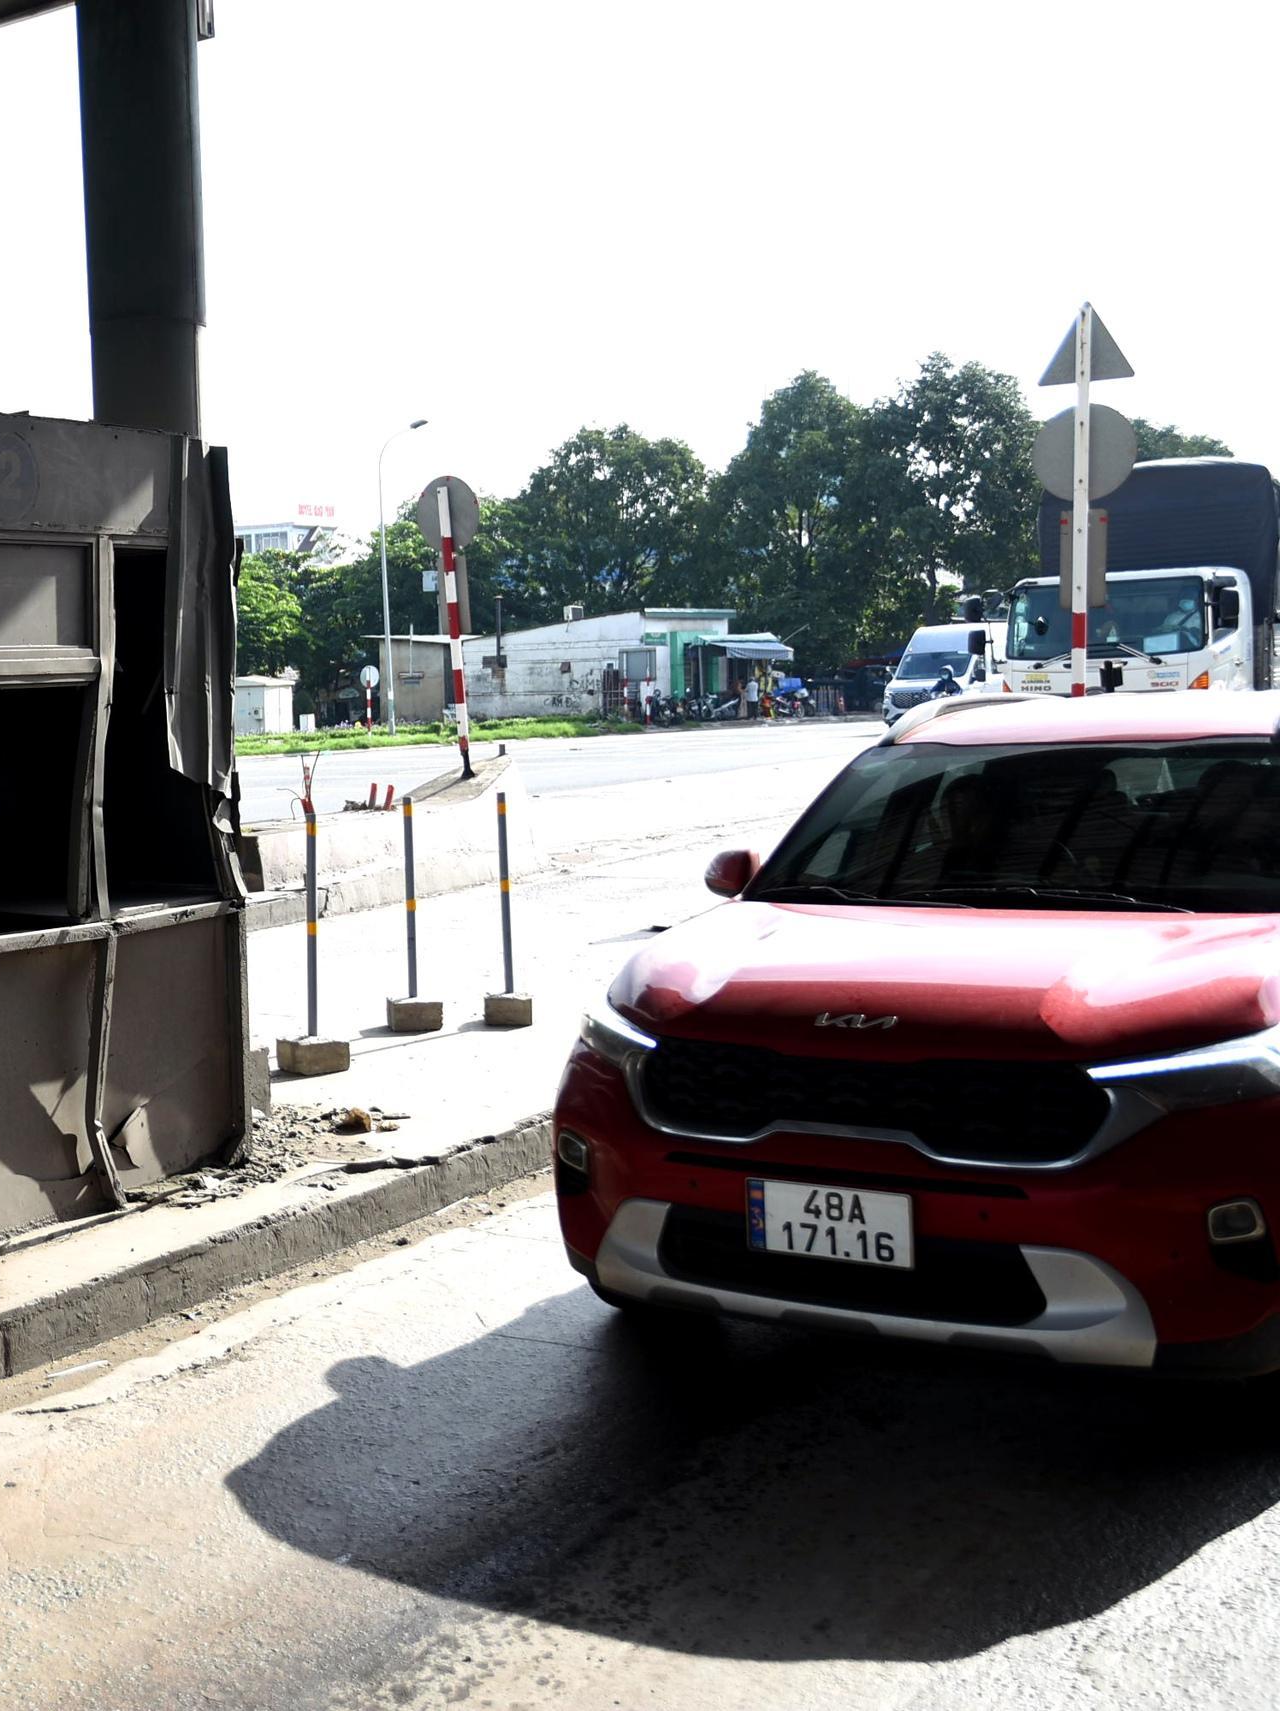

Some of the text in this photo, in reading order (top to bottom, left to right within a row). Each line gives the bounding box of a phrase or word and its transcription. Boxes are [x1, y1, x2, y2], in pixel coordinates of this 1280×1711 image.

[813, 1012, 899, 1030] KIA
[804, 1189, 867, 1225] 48A
[782, 1220, 897, 1263] 171.16
